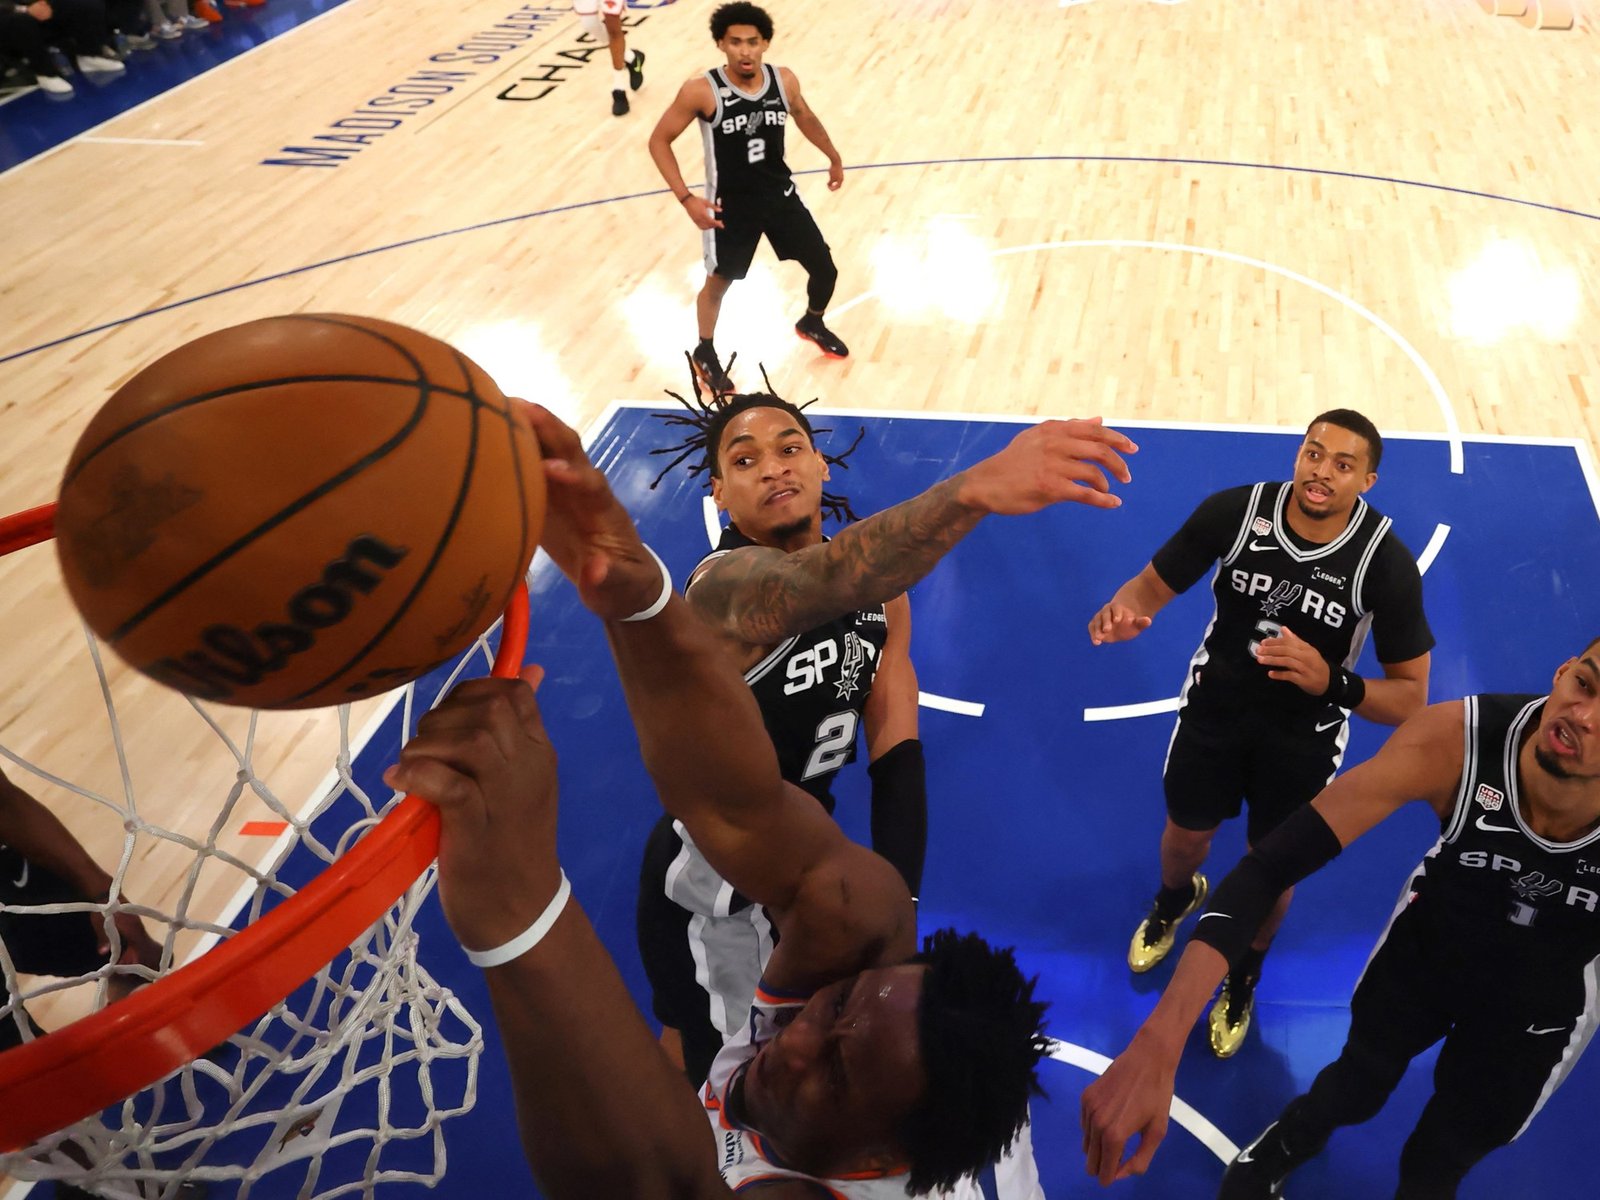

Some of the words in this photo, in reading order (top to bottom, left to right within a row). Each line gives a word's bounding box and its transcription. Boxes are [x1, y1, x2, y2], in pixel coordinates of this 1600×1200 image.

[259, 70, 477, 167] MADISON
[430, 4, 574, 64] SQUARE
[747, 138, 766, 164] 2
[1316, 571, 1342, 586] LEDGER
[861, 612, 885, 623] LEDGE
[801, 708, 860, 781] 2
[1458, 851, 1600, 913] SPUR
